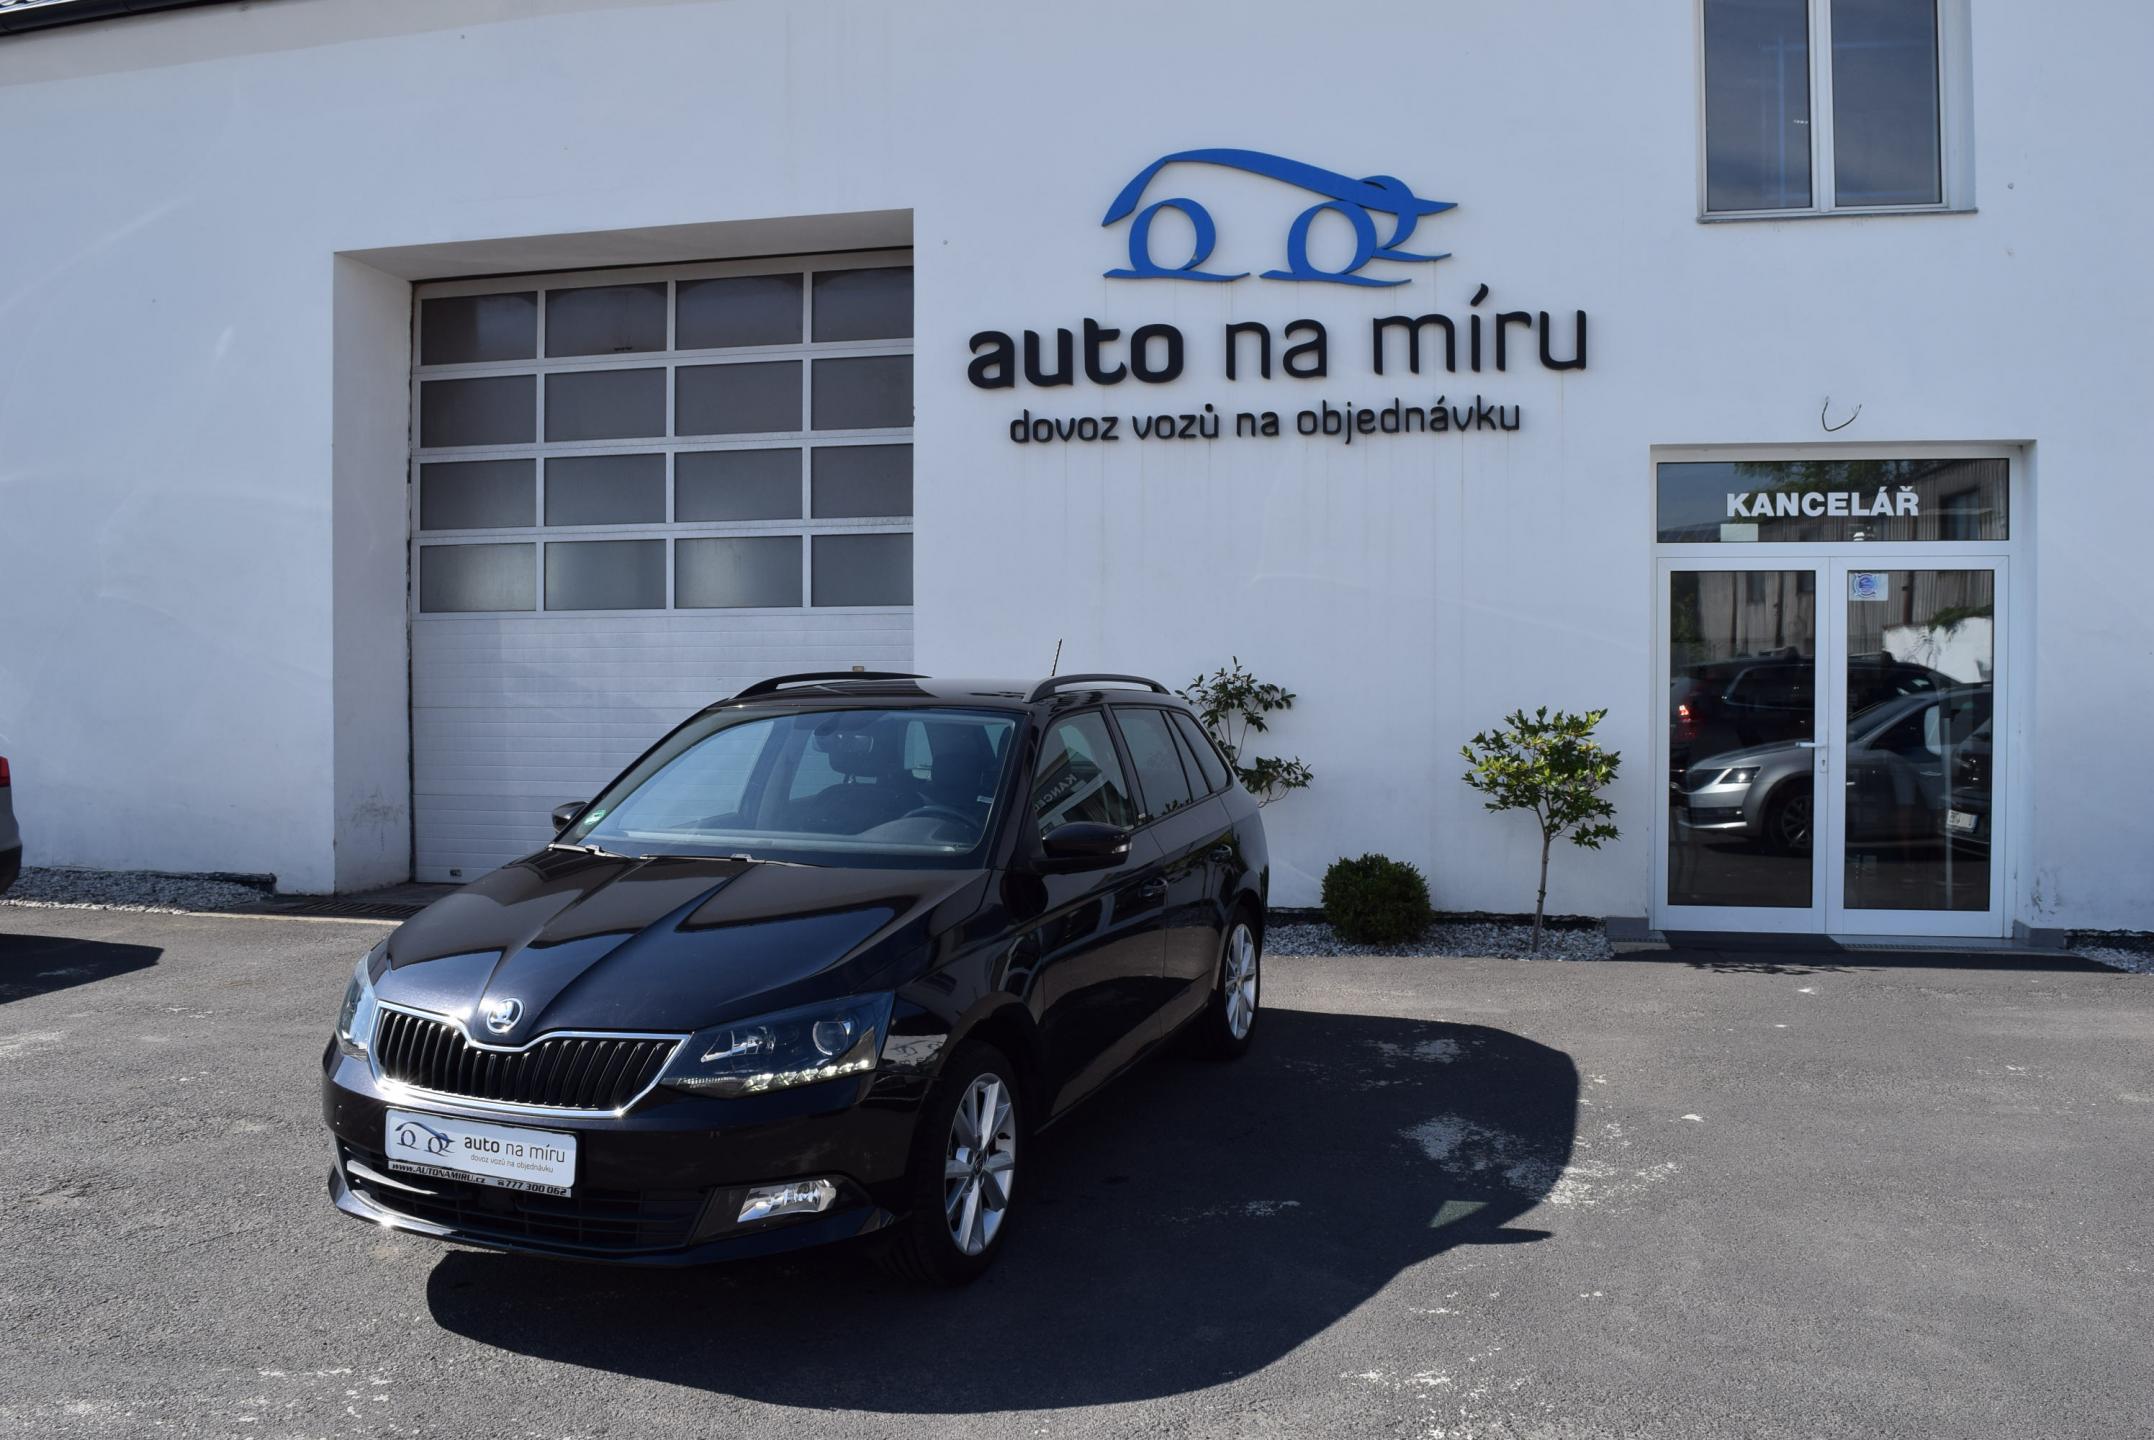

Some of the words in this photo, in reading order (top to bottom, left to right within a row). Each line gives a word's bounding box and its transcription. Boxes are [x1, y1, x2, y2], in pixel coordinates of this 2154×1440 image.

[967, 317, 1185, 390] auto
[1226, 317, 1328, 381] na
[1372, 283, 1588, 375] míru
[1009, 409, 1119, 444] dovoz
[1132, 403, 1219, 440] vozů
[1236, 410, 1280, 438] na
[1297, 396, 1521, 445] objednávku
[1726, 486, 1919, 517] KANCELÁŘ
[464, 1136, 500, 1153] auto
[505, 1143, 524, 1157] na
[529, 1144, 566, 1163] míru
[470, 1154, 489, 1163] dovoz
[547, 1186, 566, 1195] 062
